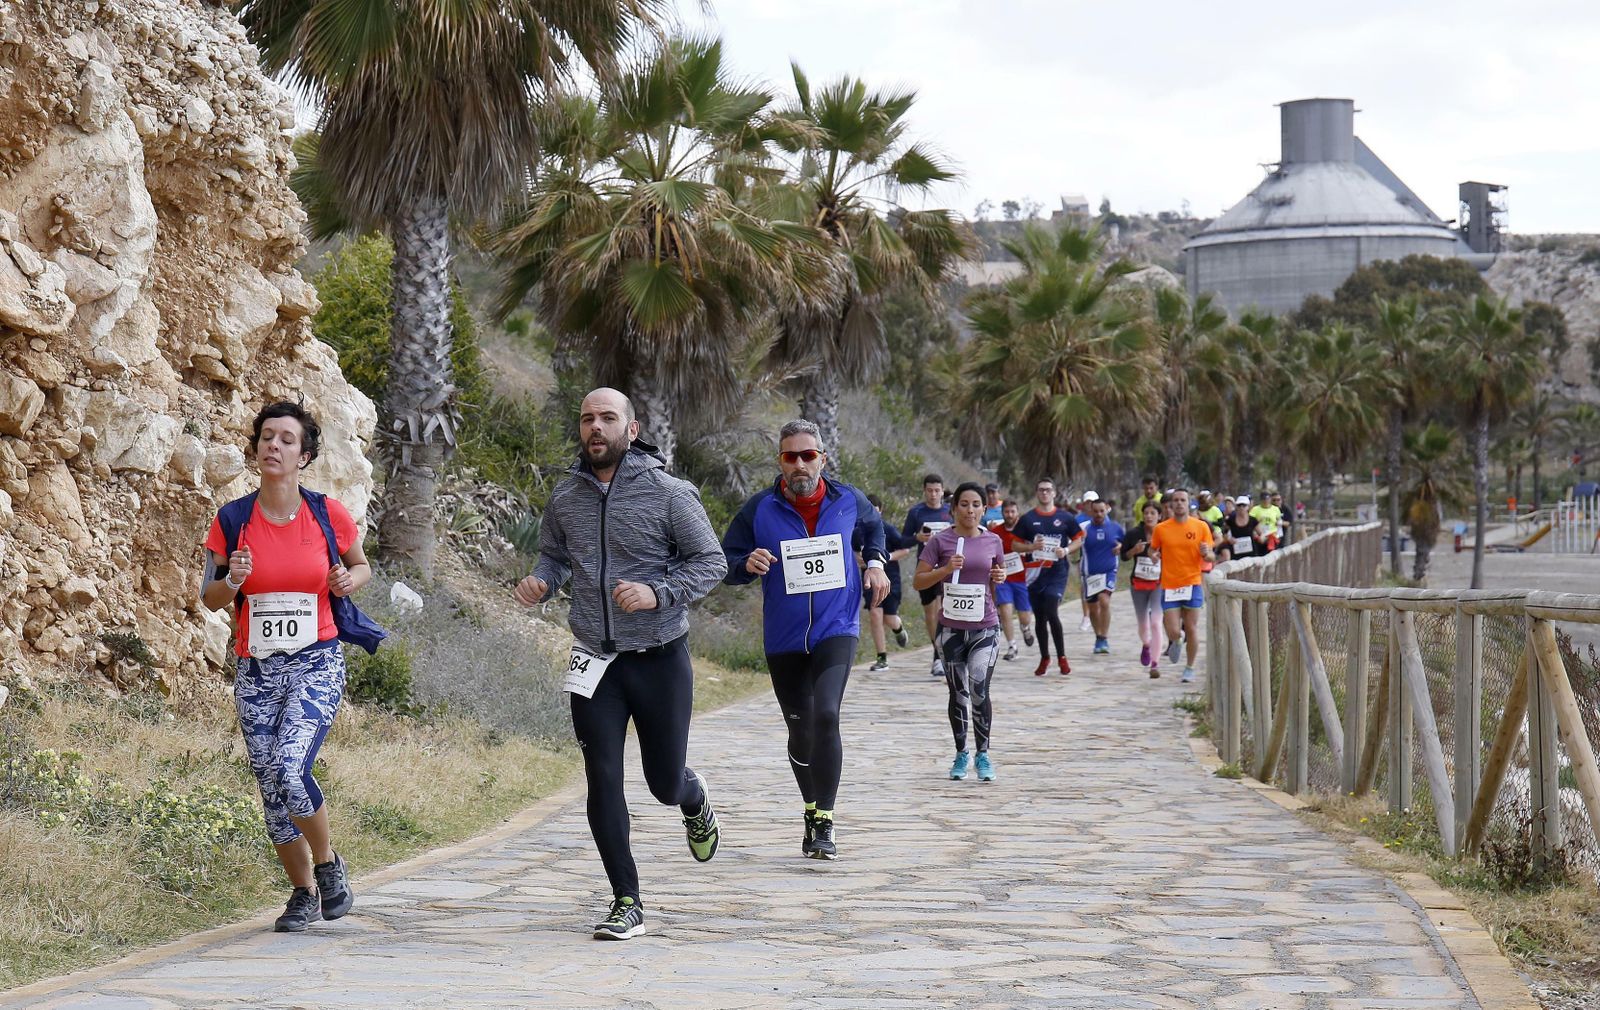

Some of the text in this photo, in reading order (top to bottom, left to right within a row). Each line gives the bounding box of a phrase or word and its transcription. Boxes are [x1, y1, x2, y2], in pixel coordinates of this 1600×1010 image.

[804, 559, 825, 575] 98
[952, 599, 974, 610] 202
[262, 619, 298, 638] 810
[567, 654, 591, 674] 64
